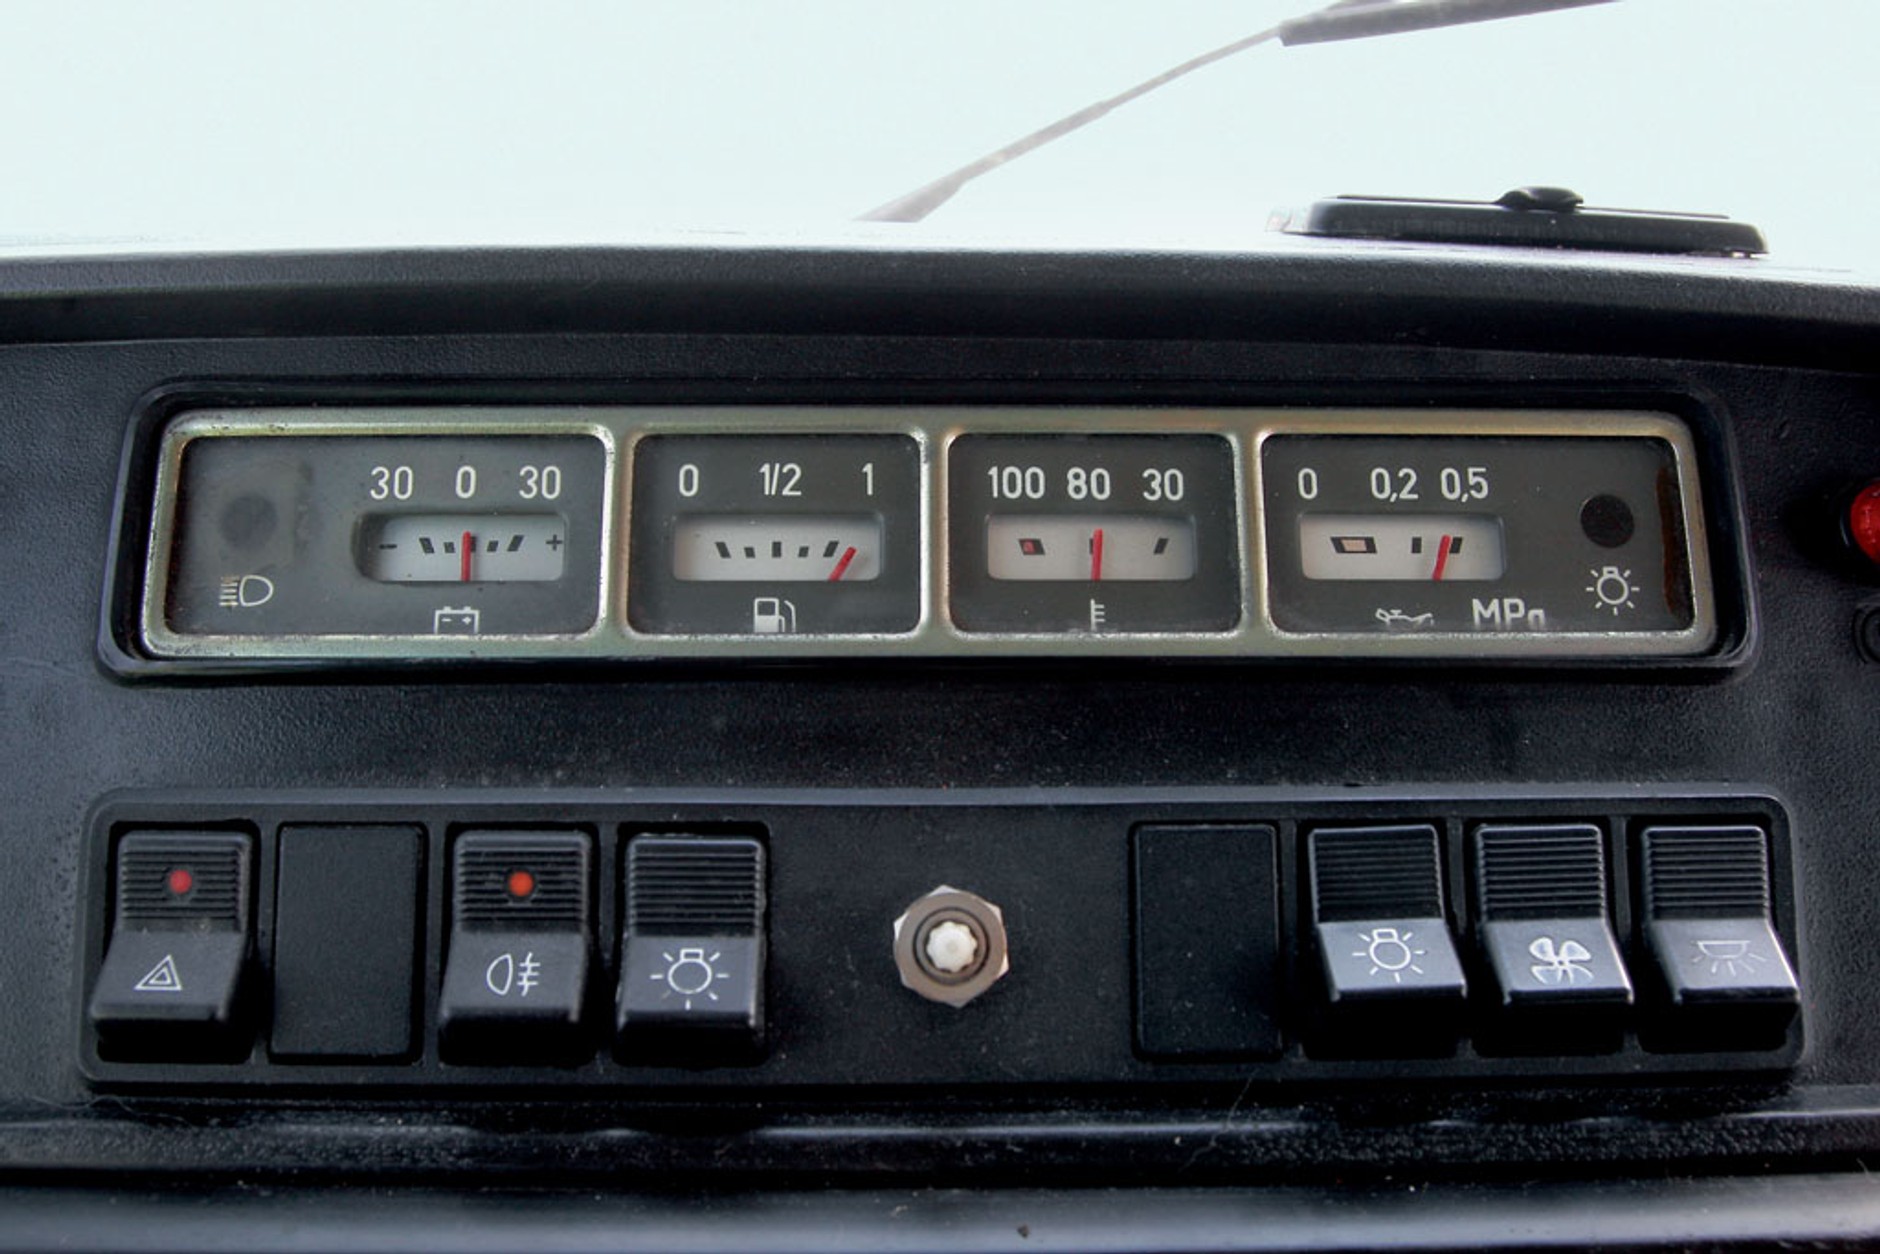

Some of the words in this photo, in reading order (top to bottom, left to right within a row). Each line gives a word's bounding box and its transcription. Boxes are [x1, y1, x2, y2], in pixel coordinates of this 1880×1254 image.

[370, 466, 413, 500] 30
[455, 465, 476, 499] 0
[519, 465, 561, 500] 30
[678, 464, 700, 497] 0
[758, 463, 802, 496] 1/2
[862, 463, 874, 496] 1
[988, 466, 1045, 499] 100
[1066, 467, 1111, 500] 80
[1142, 468, 1184, 501] 30
[1297, 467, 1318, 500] 0
[1370, 467, 1419, 503] 0,2
[1440, 467, 1489, 503] 0,5
